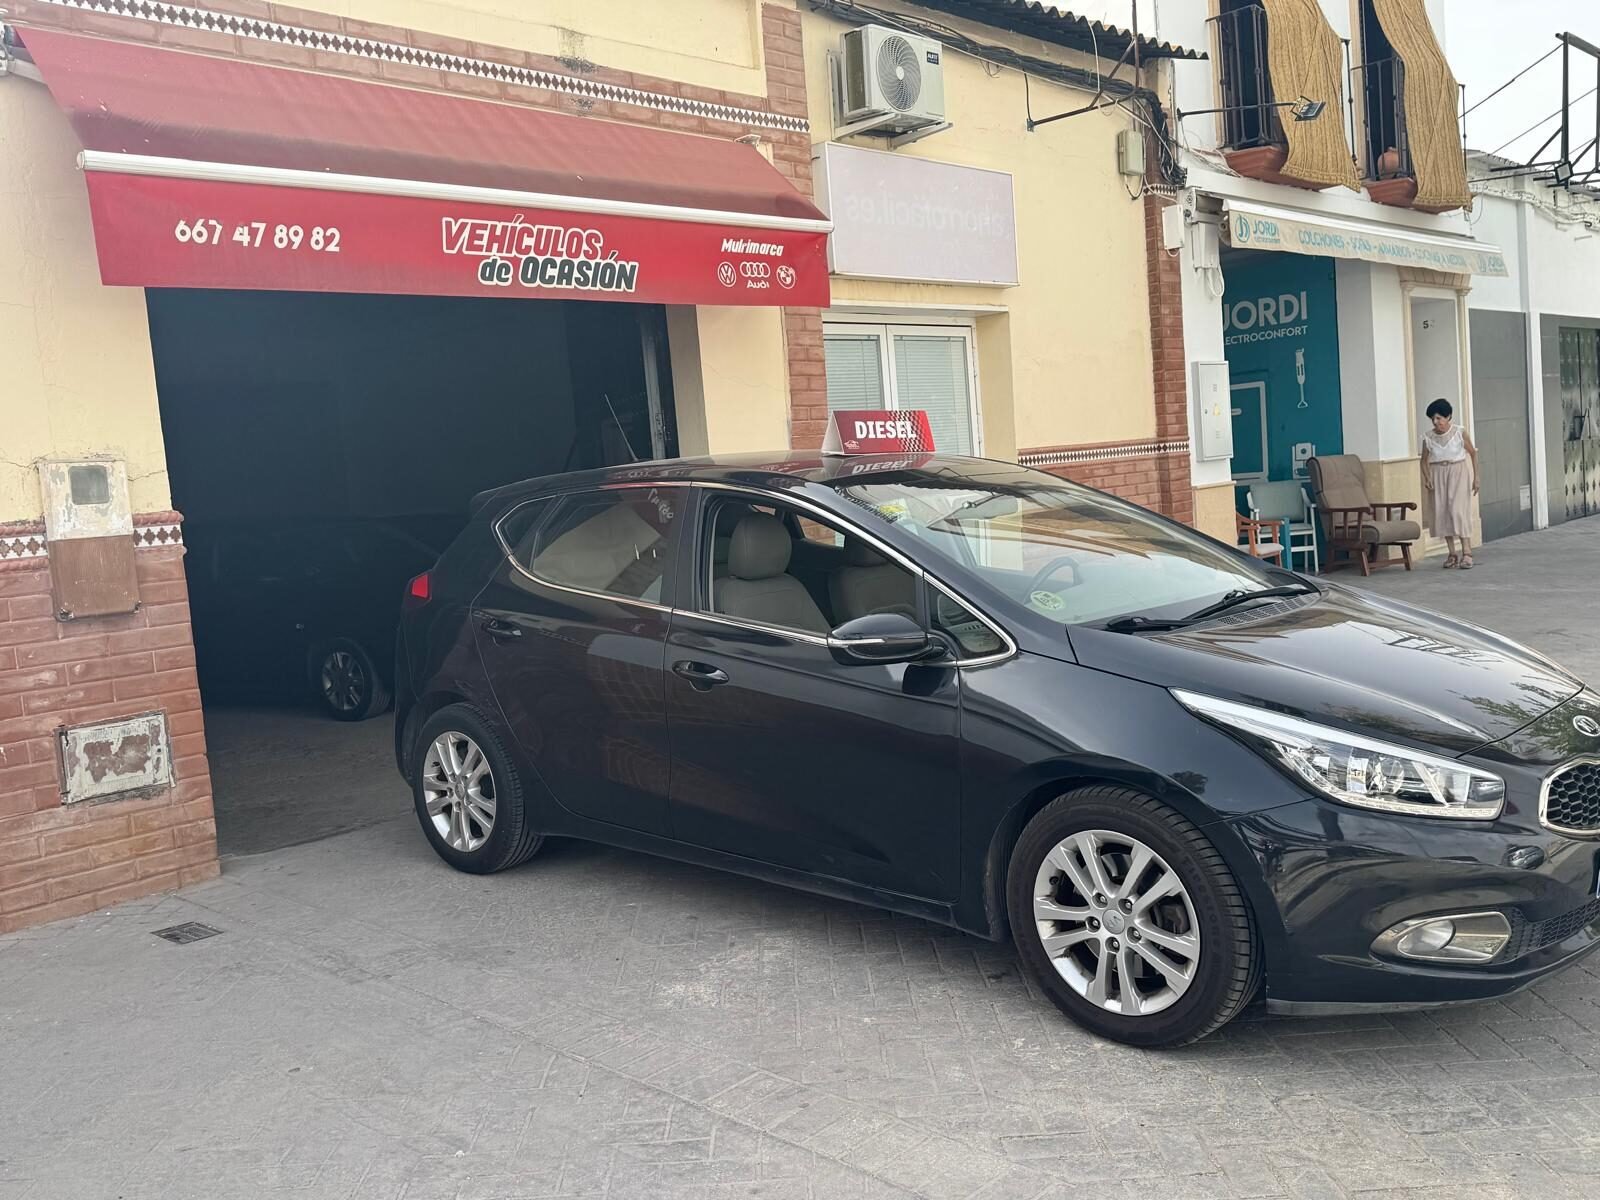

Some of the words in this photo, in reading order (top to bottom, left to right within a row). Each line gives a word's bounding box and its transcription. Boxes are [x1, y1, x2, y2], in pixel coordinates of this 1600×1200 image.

[174, 218, 223, 245] 667
[232, 221, 267, 247] 47
[273, 224, 304, 250] 89
[310, 226, 341, 252] 82
[441, 214, 604, 260] VEHÍCULOS
[1253, 219, 1280, 238] JORDI
[478, 256, 514, 286] de
[518, 250, 639, 293] OCASIÓN
[746, 279, 770, 288] Audi
[1223, 291, 1308, 331] JORDI
[1423, 319, 1430, 329] 5
[1223, 325, 1308, 346] ECTROCONFORT
[855, 420, 917, 439] DIESEL
